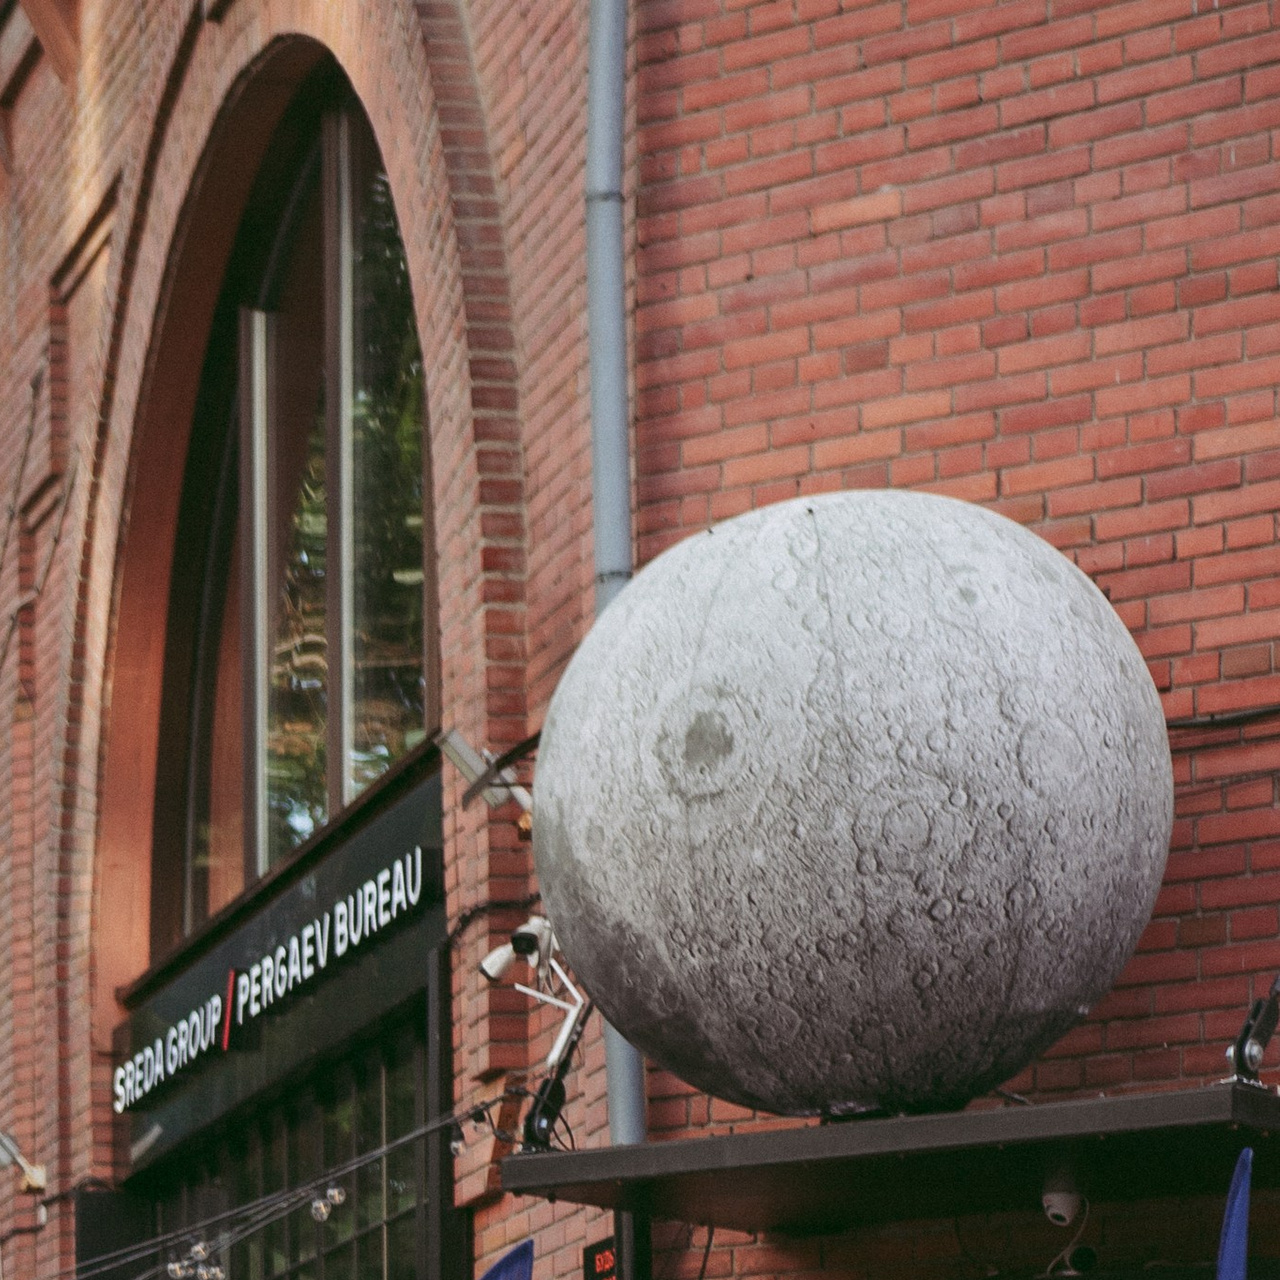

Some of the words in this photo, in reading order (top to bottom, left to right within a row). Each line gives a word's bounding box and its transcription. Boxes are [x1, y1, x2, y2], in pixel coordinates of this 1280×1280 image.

[114, 1038, 165, 1114] SREDA
[165, 994, 222, 1076] GROUP
[236, 911, 330, 1025] PERGAEV
[334, 845, 422, 957] BUREAU
